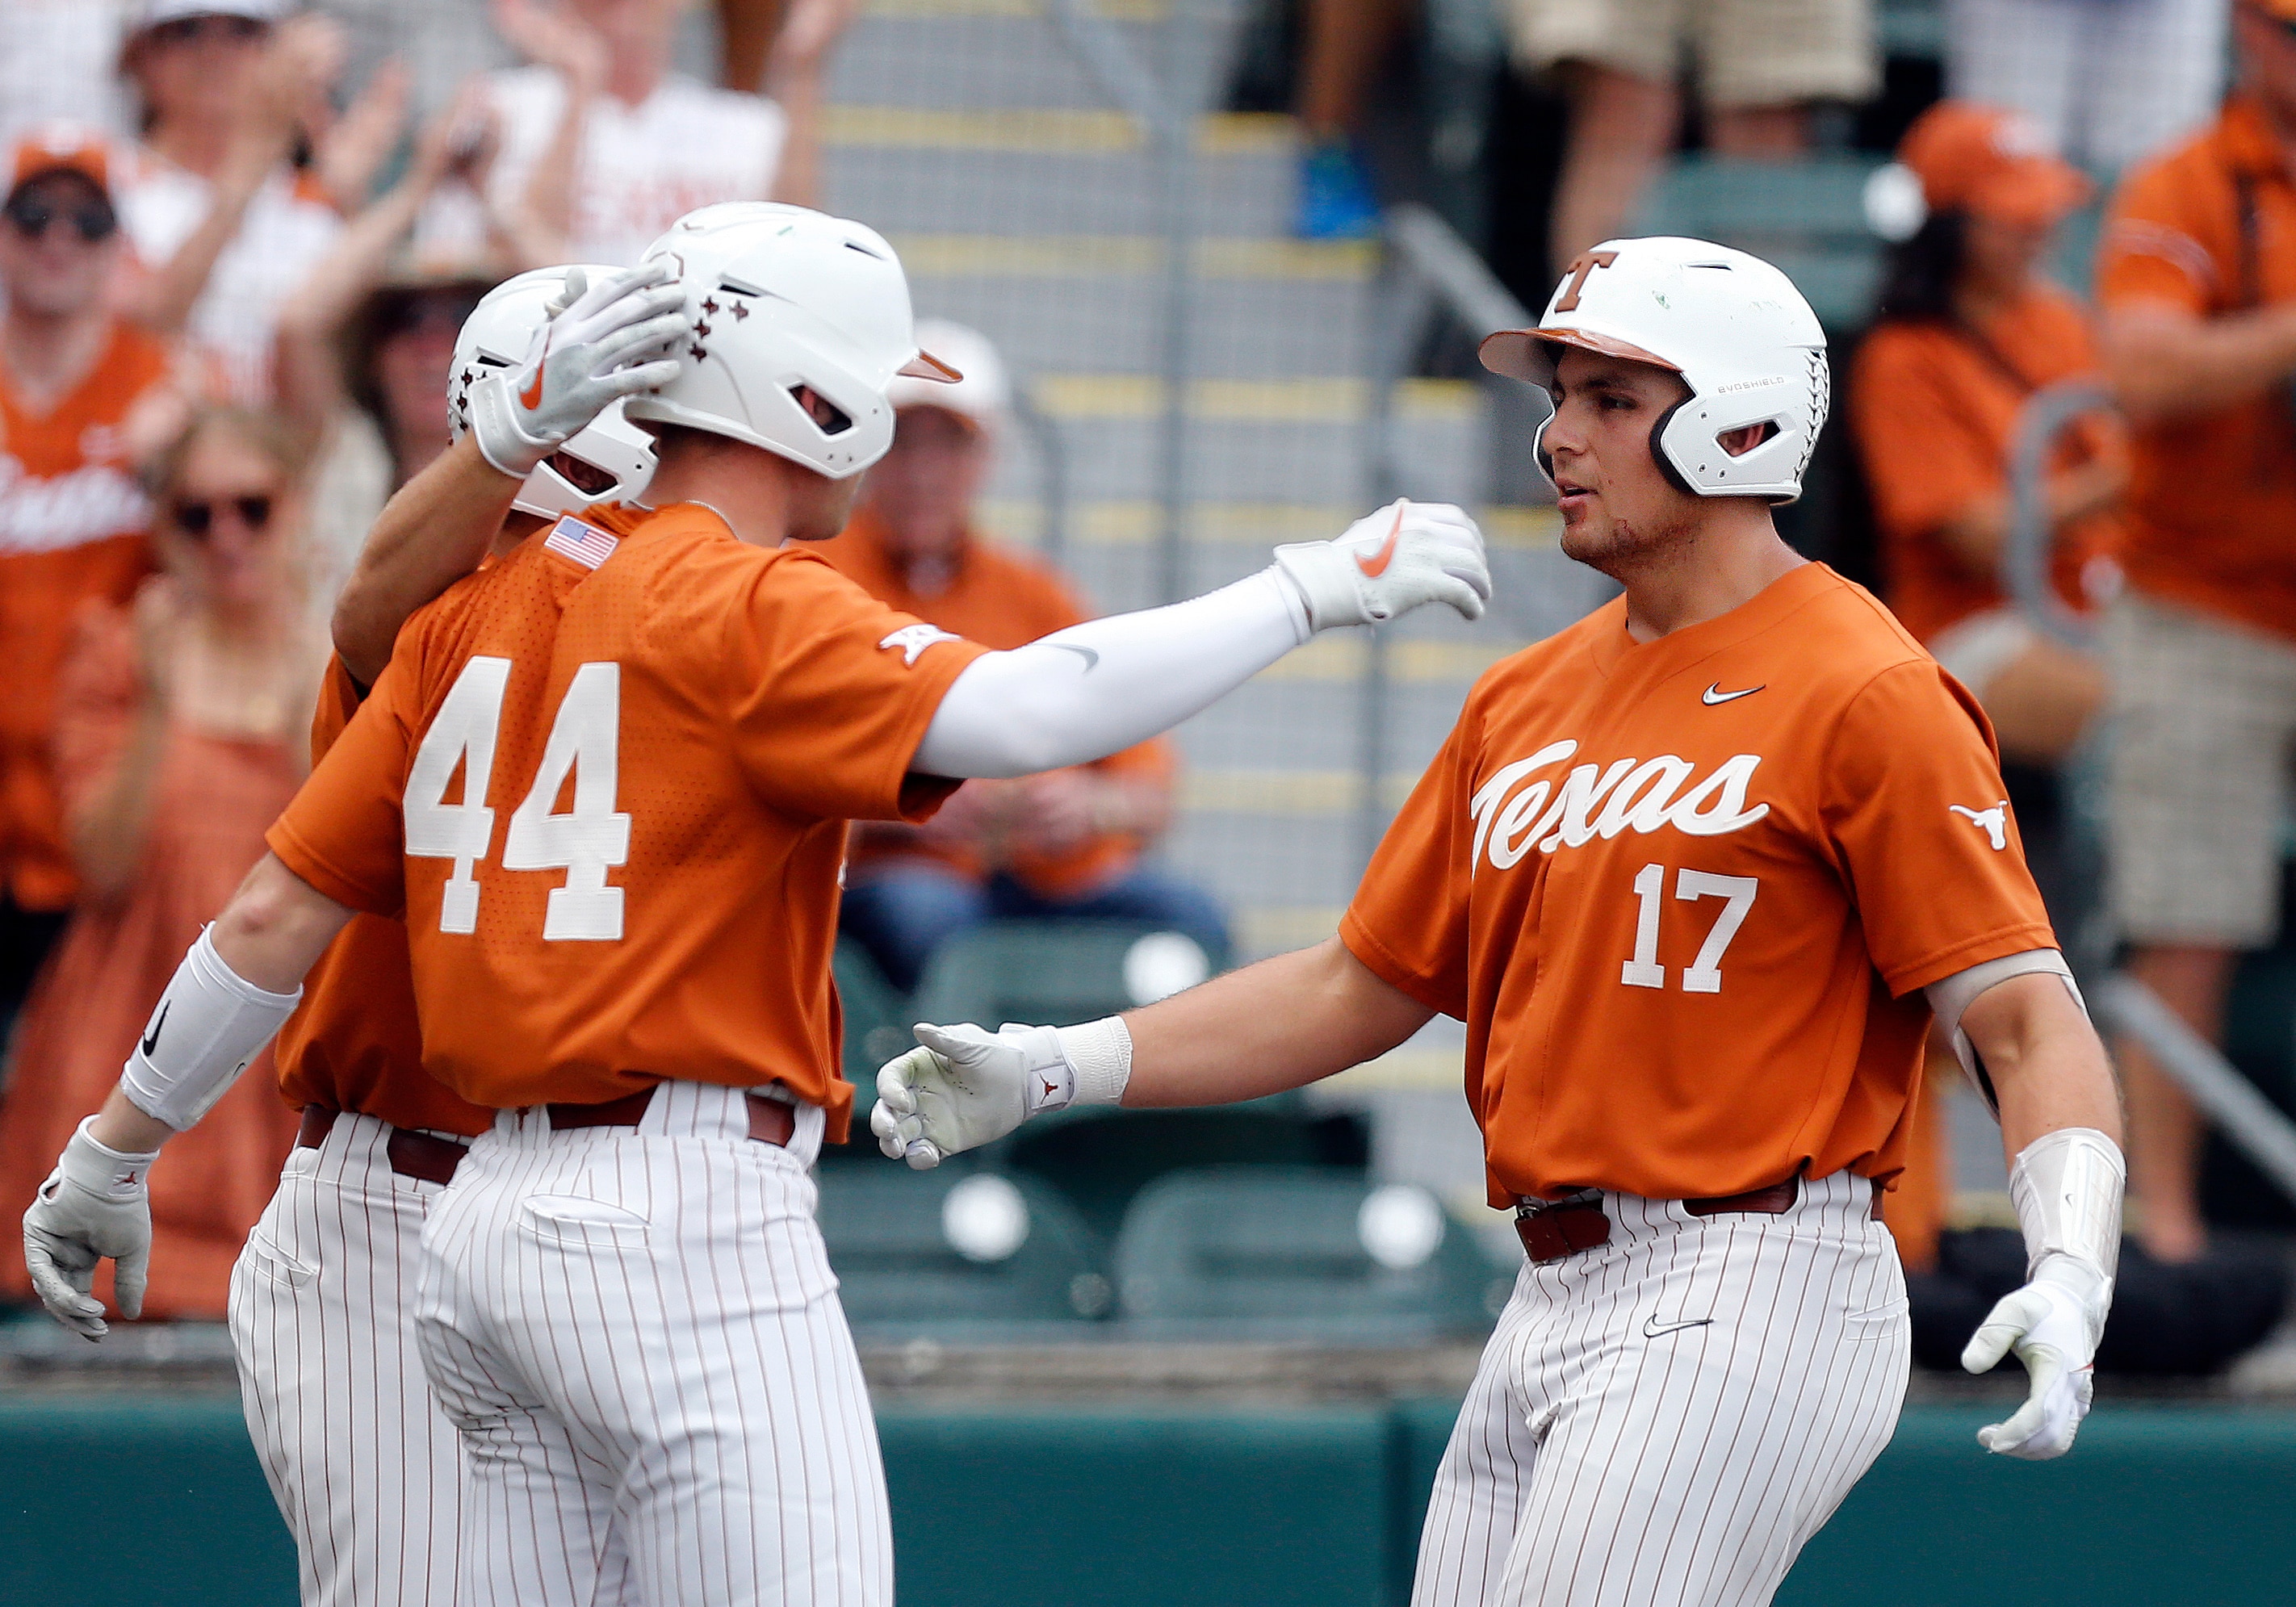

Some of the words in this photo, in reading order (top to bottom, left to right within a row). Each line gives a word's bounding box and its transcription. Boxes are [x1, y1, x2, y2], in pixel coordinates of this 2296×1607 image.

[1554, 251, 1619, 312] T
[403, 655, 632, 940] 44
[1471, 739, 1770, 881] Texas
[1621, 863, 1759, 994] 17
